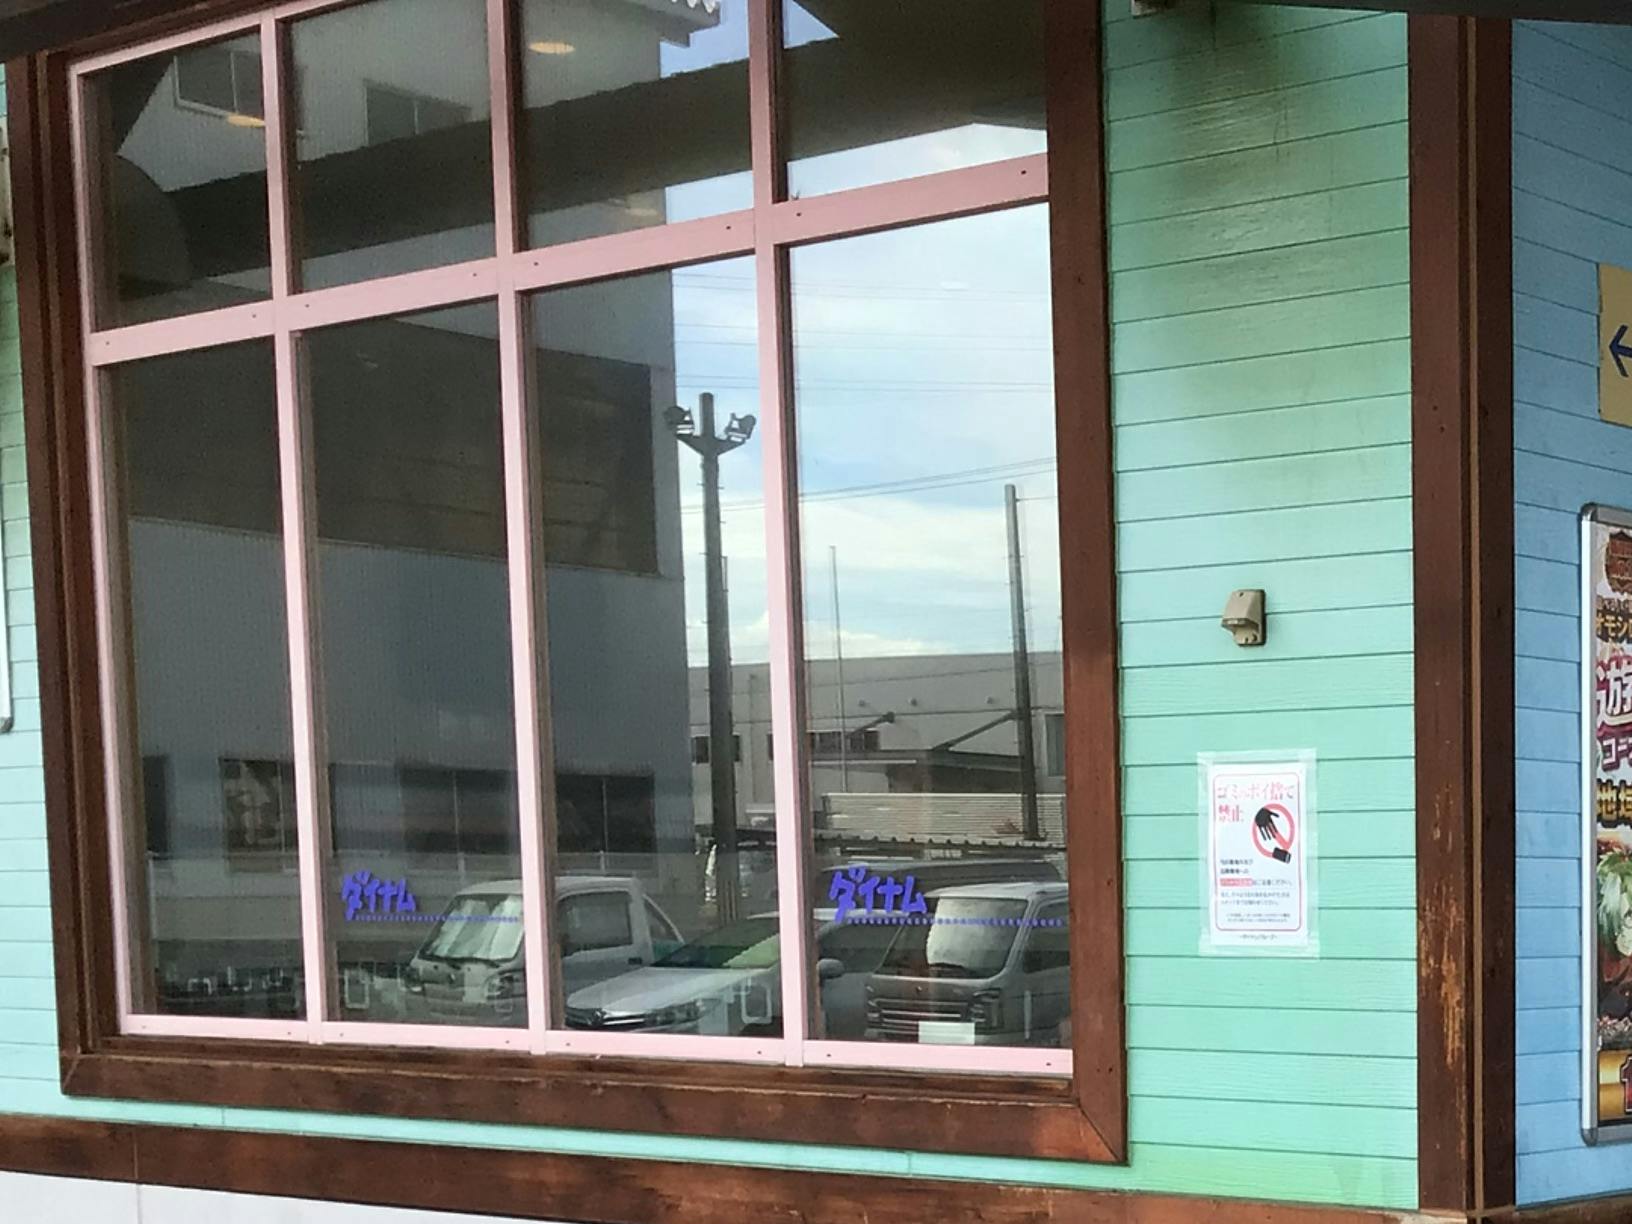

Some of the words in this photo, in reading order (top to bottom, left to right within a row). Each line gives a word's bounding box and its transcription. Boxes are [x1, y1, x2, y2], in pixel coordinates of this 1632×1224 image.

[341, 870, 416, 921] ダイナム
[829, 864, 928, 925] ダイナム
